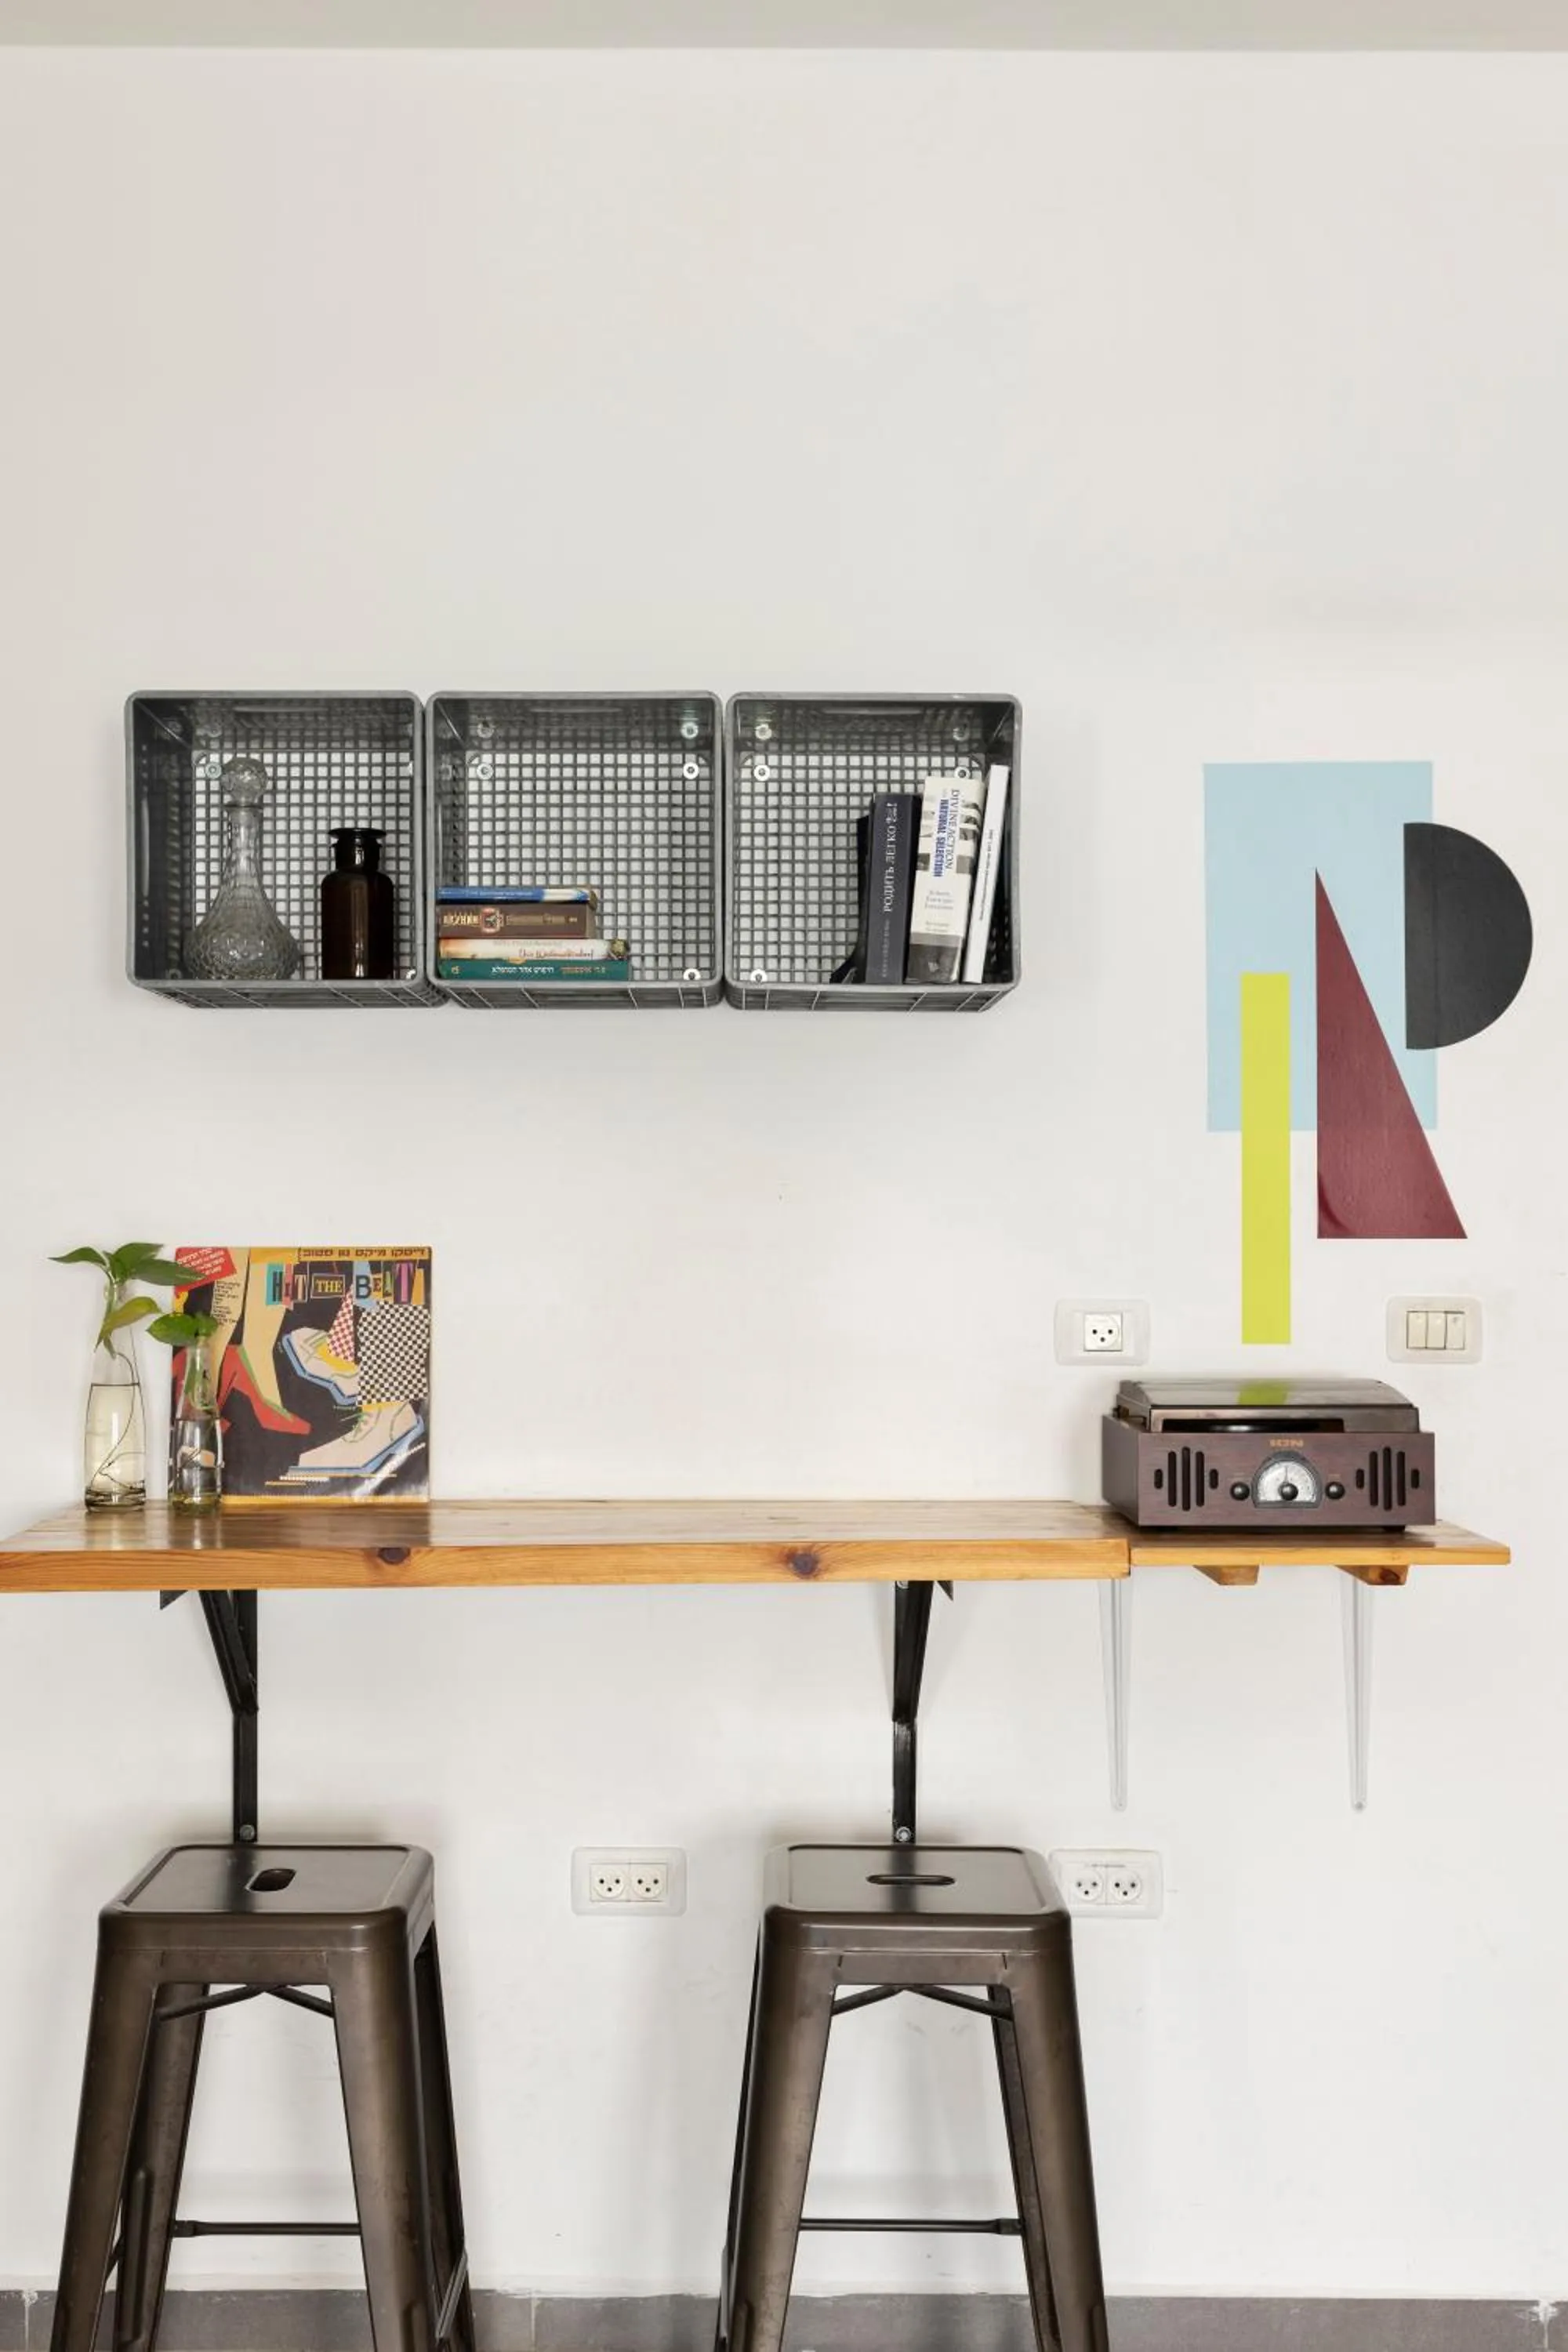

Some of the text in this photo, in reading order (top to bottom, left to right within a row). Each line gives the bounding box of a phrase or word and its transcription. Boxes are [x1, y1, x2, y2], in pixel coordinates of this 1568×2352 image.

[936, 799, 949, 833] NATURAL
[946, 789, 960, 869] DIVINE ACTION
[885, 826, 898, 865] ЛЕГКО
[933, 837, 946, 877] SELECTION
[883, 867, 895, 913] РОДИТЬ
[316, 1279, 343, 1294] THE
